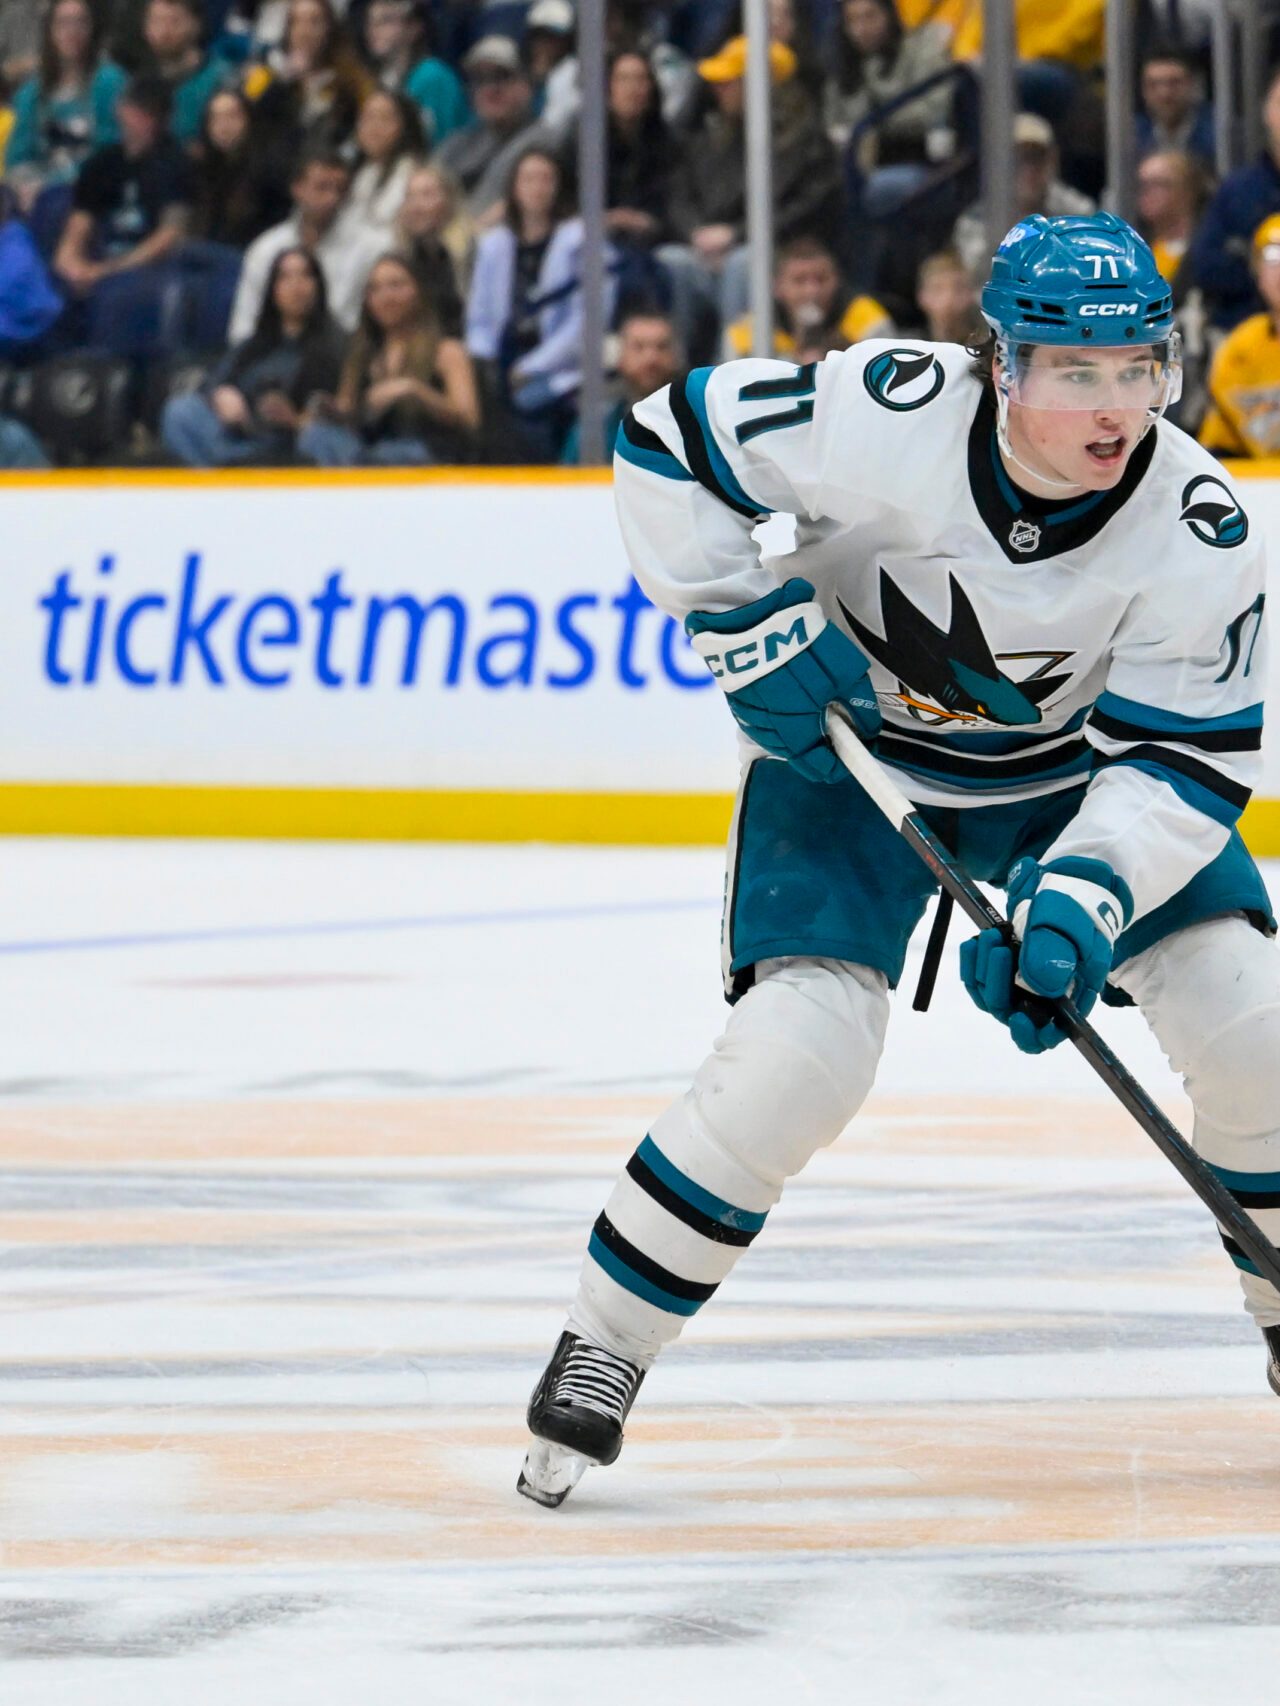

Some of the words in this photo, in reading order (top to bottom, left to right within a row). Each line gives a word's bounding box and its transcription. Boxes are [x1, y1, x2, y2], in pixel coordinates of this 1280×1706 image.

[1083, 255, 1120, 279] 71
[1078, 303, 1139, 317] CCM
[1015, 531, 1035, 543] NHL
[38, 551, 716, 690] ticketmaste
[703, 616, 809, 678] CCM
